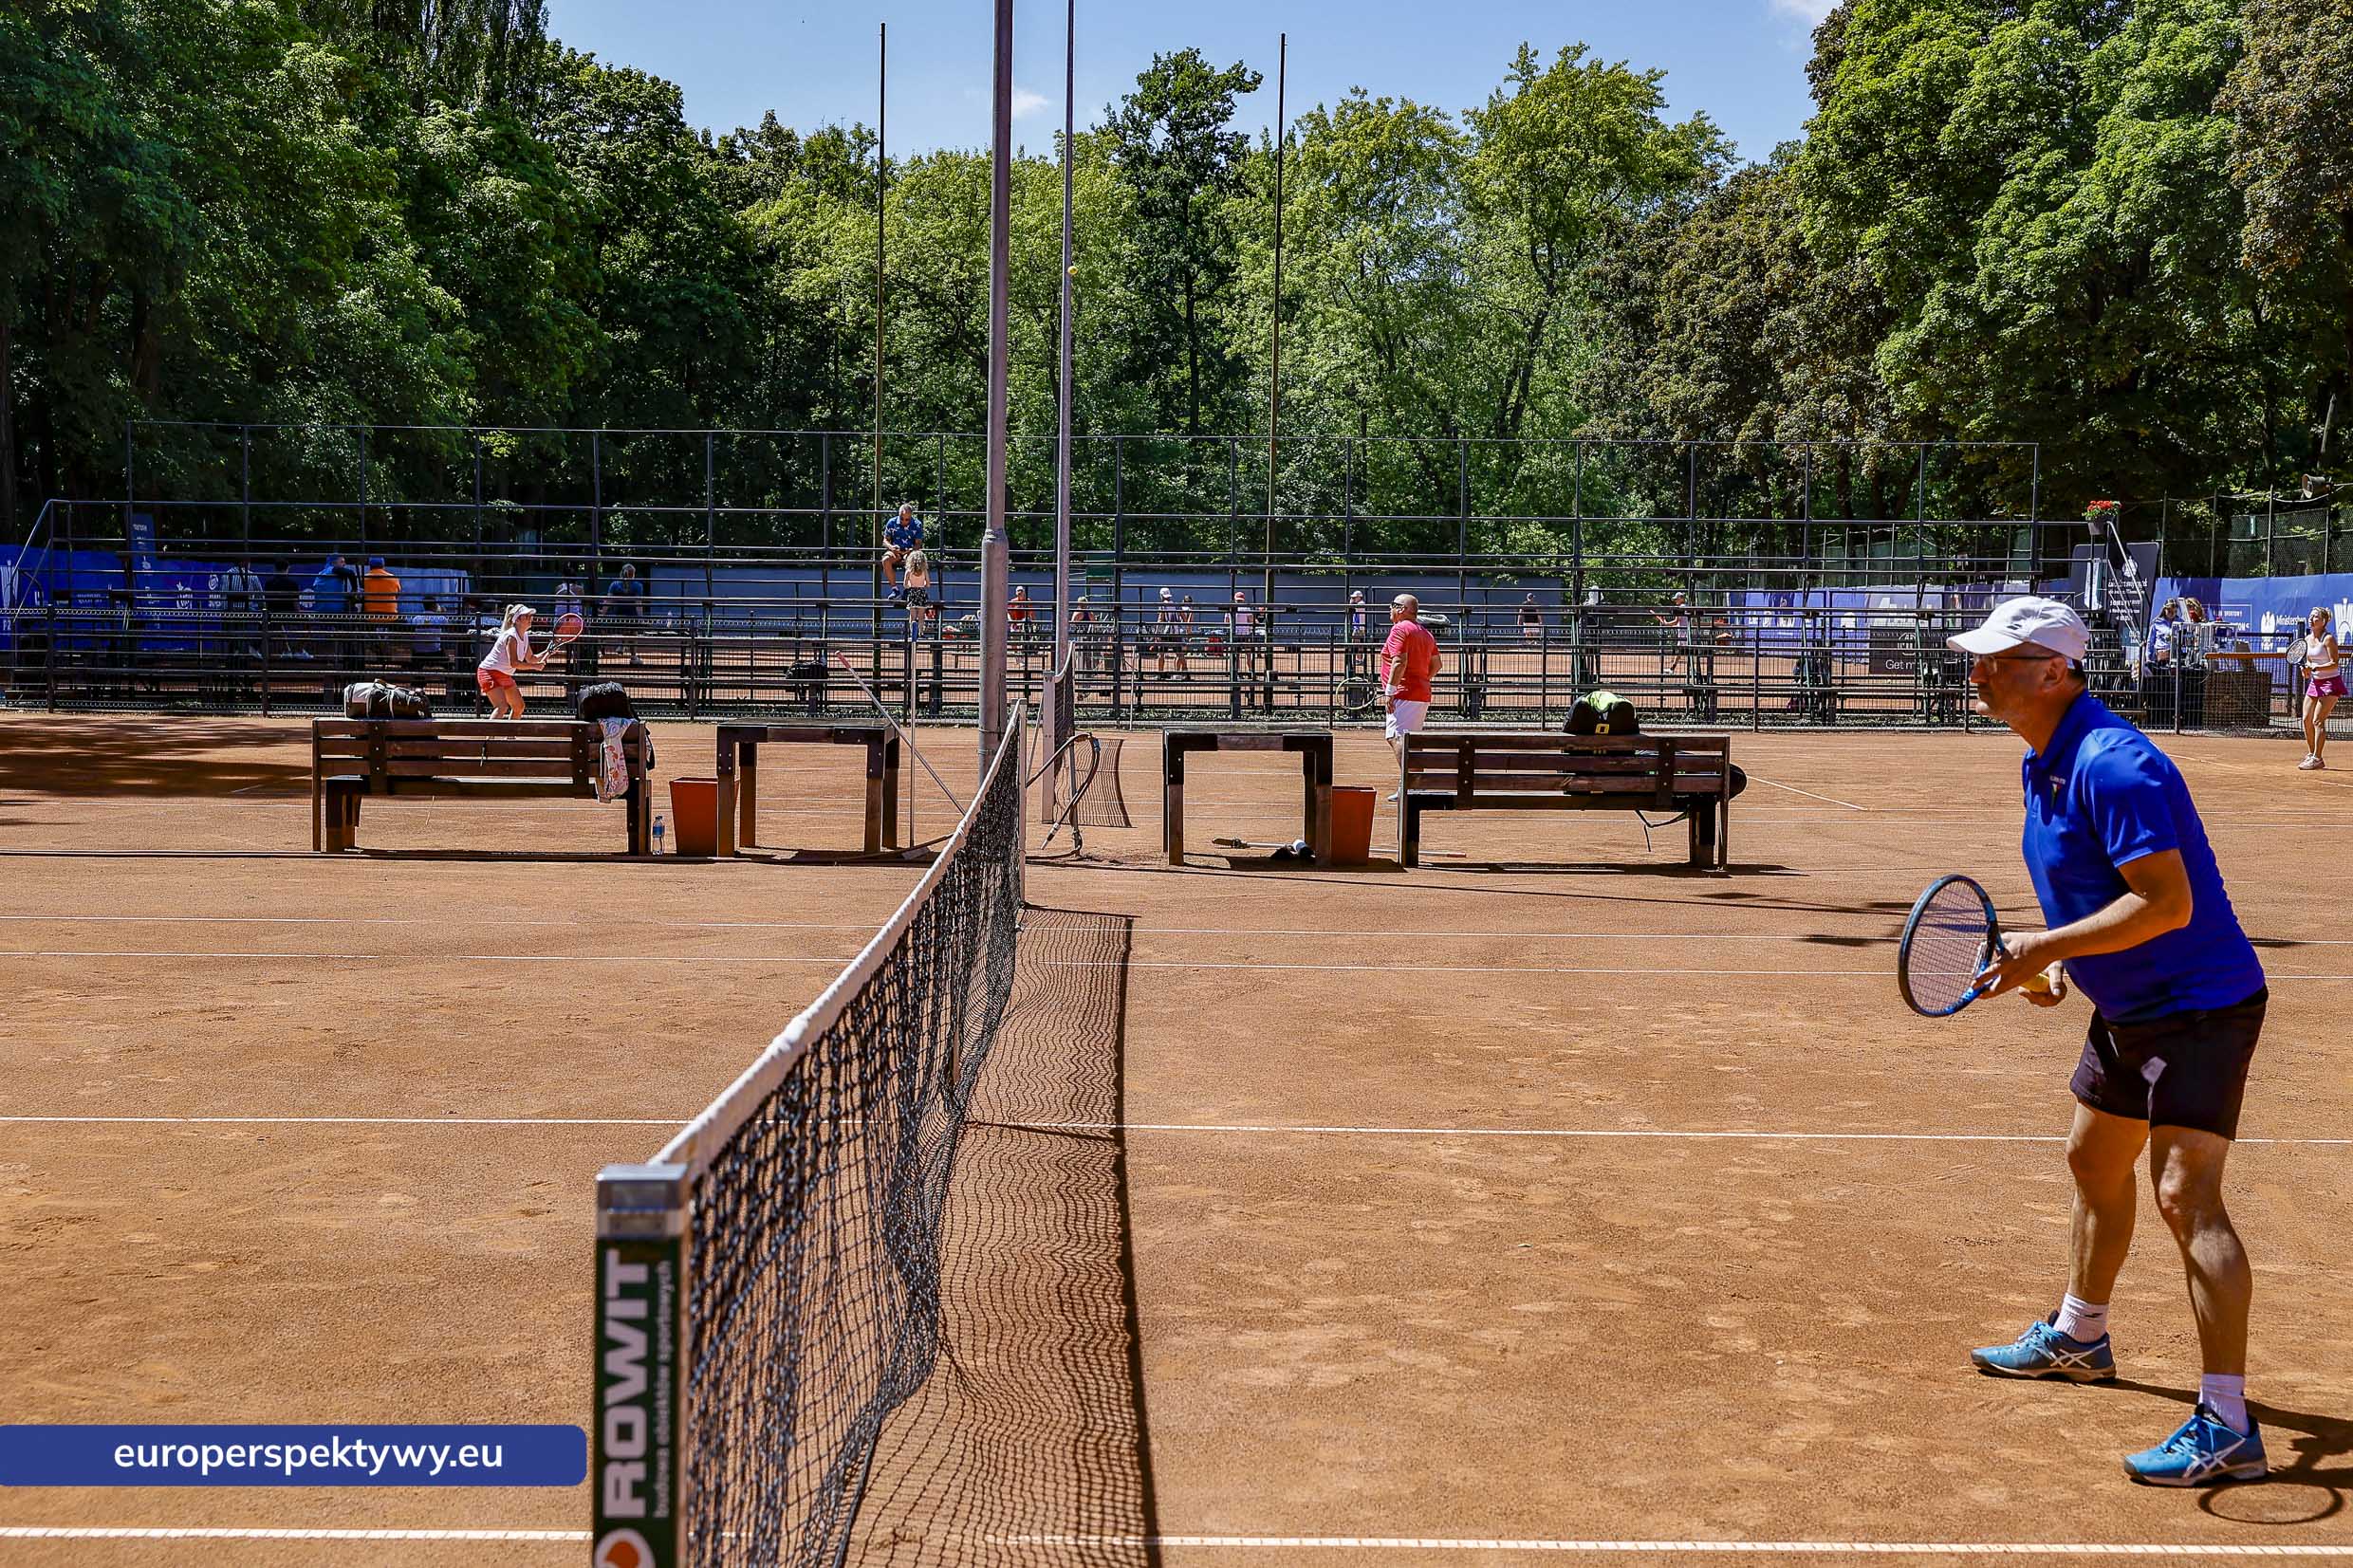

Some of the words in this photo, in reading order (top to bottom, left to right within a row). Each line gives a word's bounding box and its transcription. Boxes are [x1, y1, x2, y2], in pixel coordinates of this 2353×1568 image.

[1885, 659, 1903, 670] Get
[655, 1261, 675, 1363] sportowych
[603, 1247, 648, 1518] ROWIT
[653, 1448, 670, 1519] budowa
